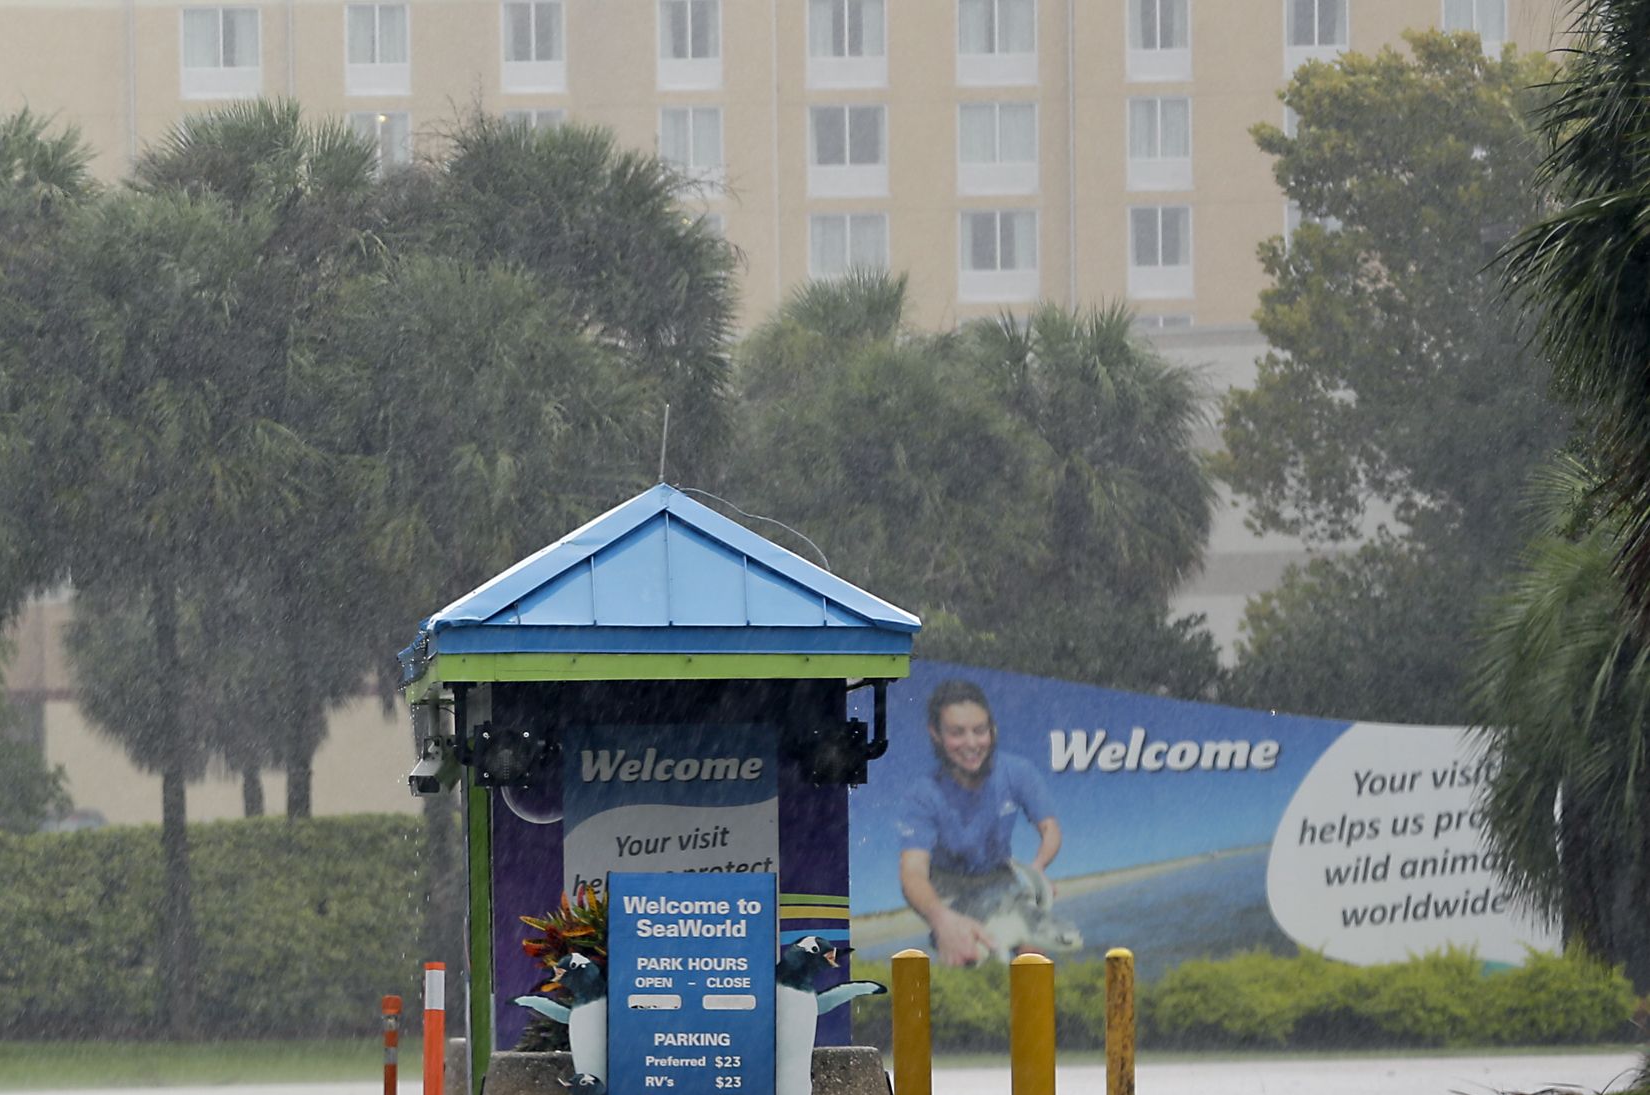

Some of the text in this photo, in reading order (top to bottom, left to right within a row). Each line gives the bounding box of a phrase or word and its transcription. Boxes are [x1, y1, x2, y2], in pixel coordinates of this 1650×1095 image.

[1050, 727, 1280, 773] Welcome
[581, 747, 764, 783] Welcome
[1354, 768, 1423, 797] Your
[1299, 813, 1382, 847] helps
[1391, 811, 1425, 836] us
[616, 826, 731, 857] Your visit
[1325, 848, 1498, 888] wild anima
[622, 895, 762, 915] Welcome to
[1341, 888, 1507, 928] worldwide
[637, 918, 747, 938] SeaWorld
[637, 957, 748, 971] PARK HOURS
[634, 977, 673, 988] OPEN
[706, 977, 751, 988] CLOSE
[654, 1033, 731, 1047] PARKING
[645, 1055, 741, 1068] Preferred $23
[645, 1076, 742, 1089] RV's $23
